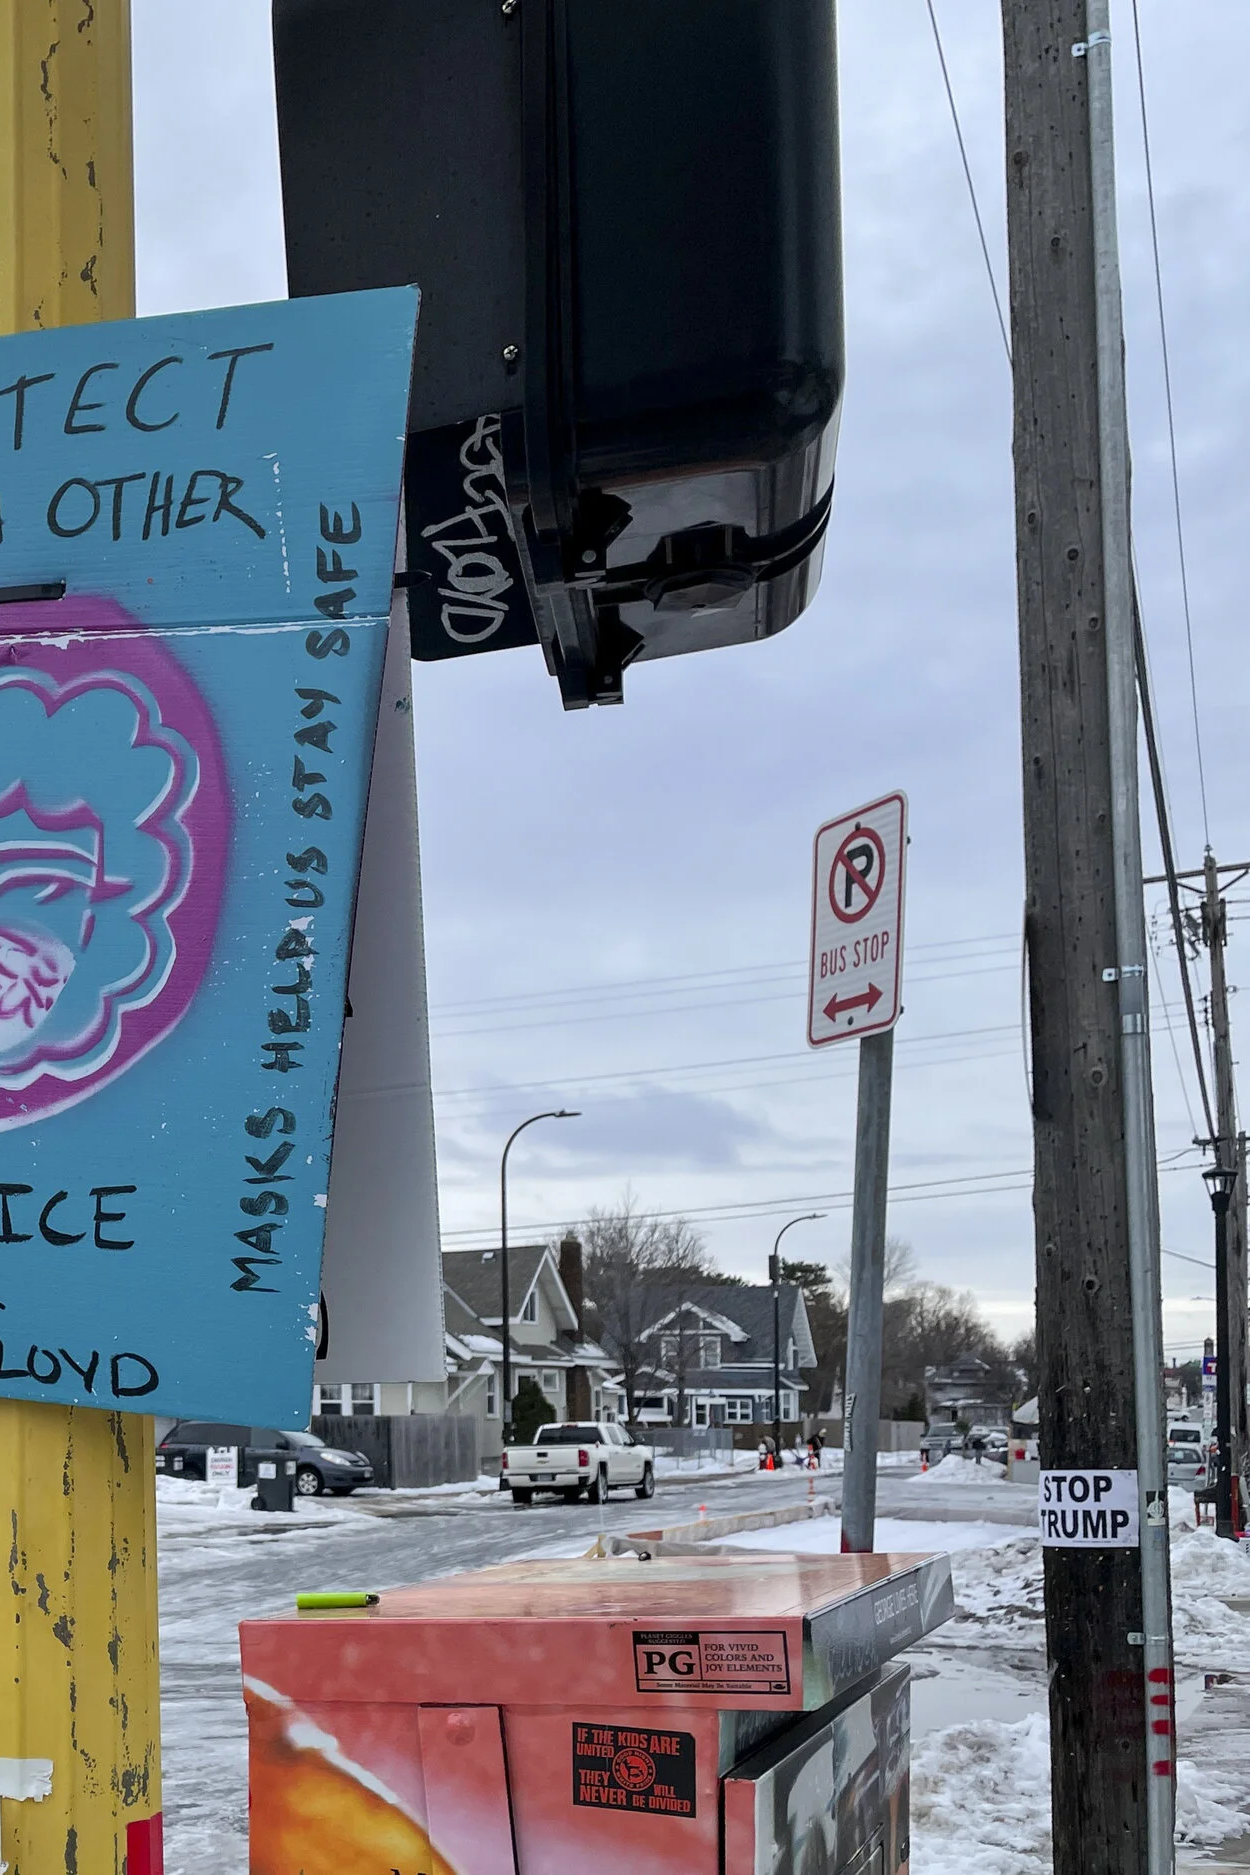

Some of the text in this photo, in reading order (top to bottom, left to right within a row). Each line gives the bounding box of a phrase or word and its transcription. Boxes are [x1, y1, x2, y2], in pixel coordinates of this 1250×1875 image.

[46, 469, 267, 540] OTHER
[229, 500, 363, 1294] MASKS HELP US STAY SAFE
[820, 931, 890, 979] BUS STOP
[1044, 1475, 1113, 1503] STOP
[1040, 1509, 1130, 1539] TRUMP
[704, 1643, 759, 1651] FOR VIVID
[704, 1653, 774, 1662] COLORS AND
[643, 1650, 696, 1675] PG
[705, 1664, 783, 1673] JOY ELEMENTS
[576, 1742, 615, 1758] UNITED
[577, 1727, 680, 1756] IF THE KIDS ARE
[578, 1769, 610, 1786] THEY
[653, 1784, 677, 1797] WILL
[579, 1785, 691, 1813] NEVER BE DIVIDED
